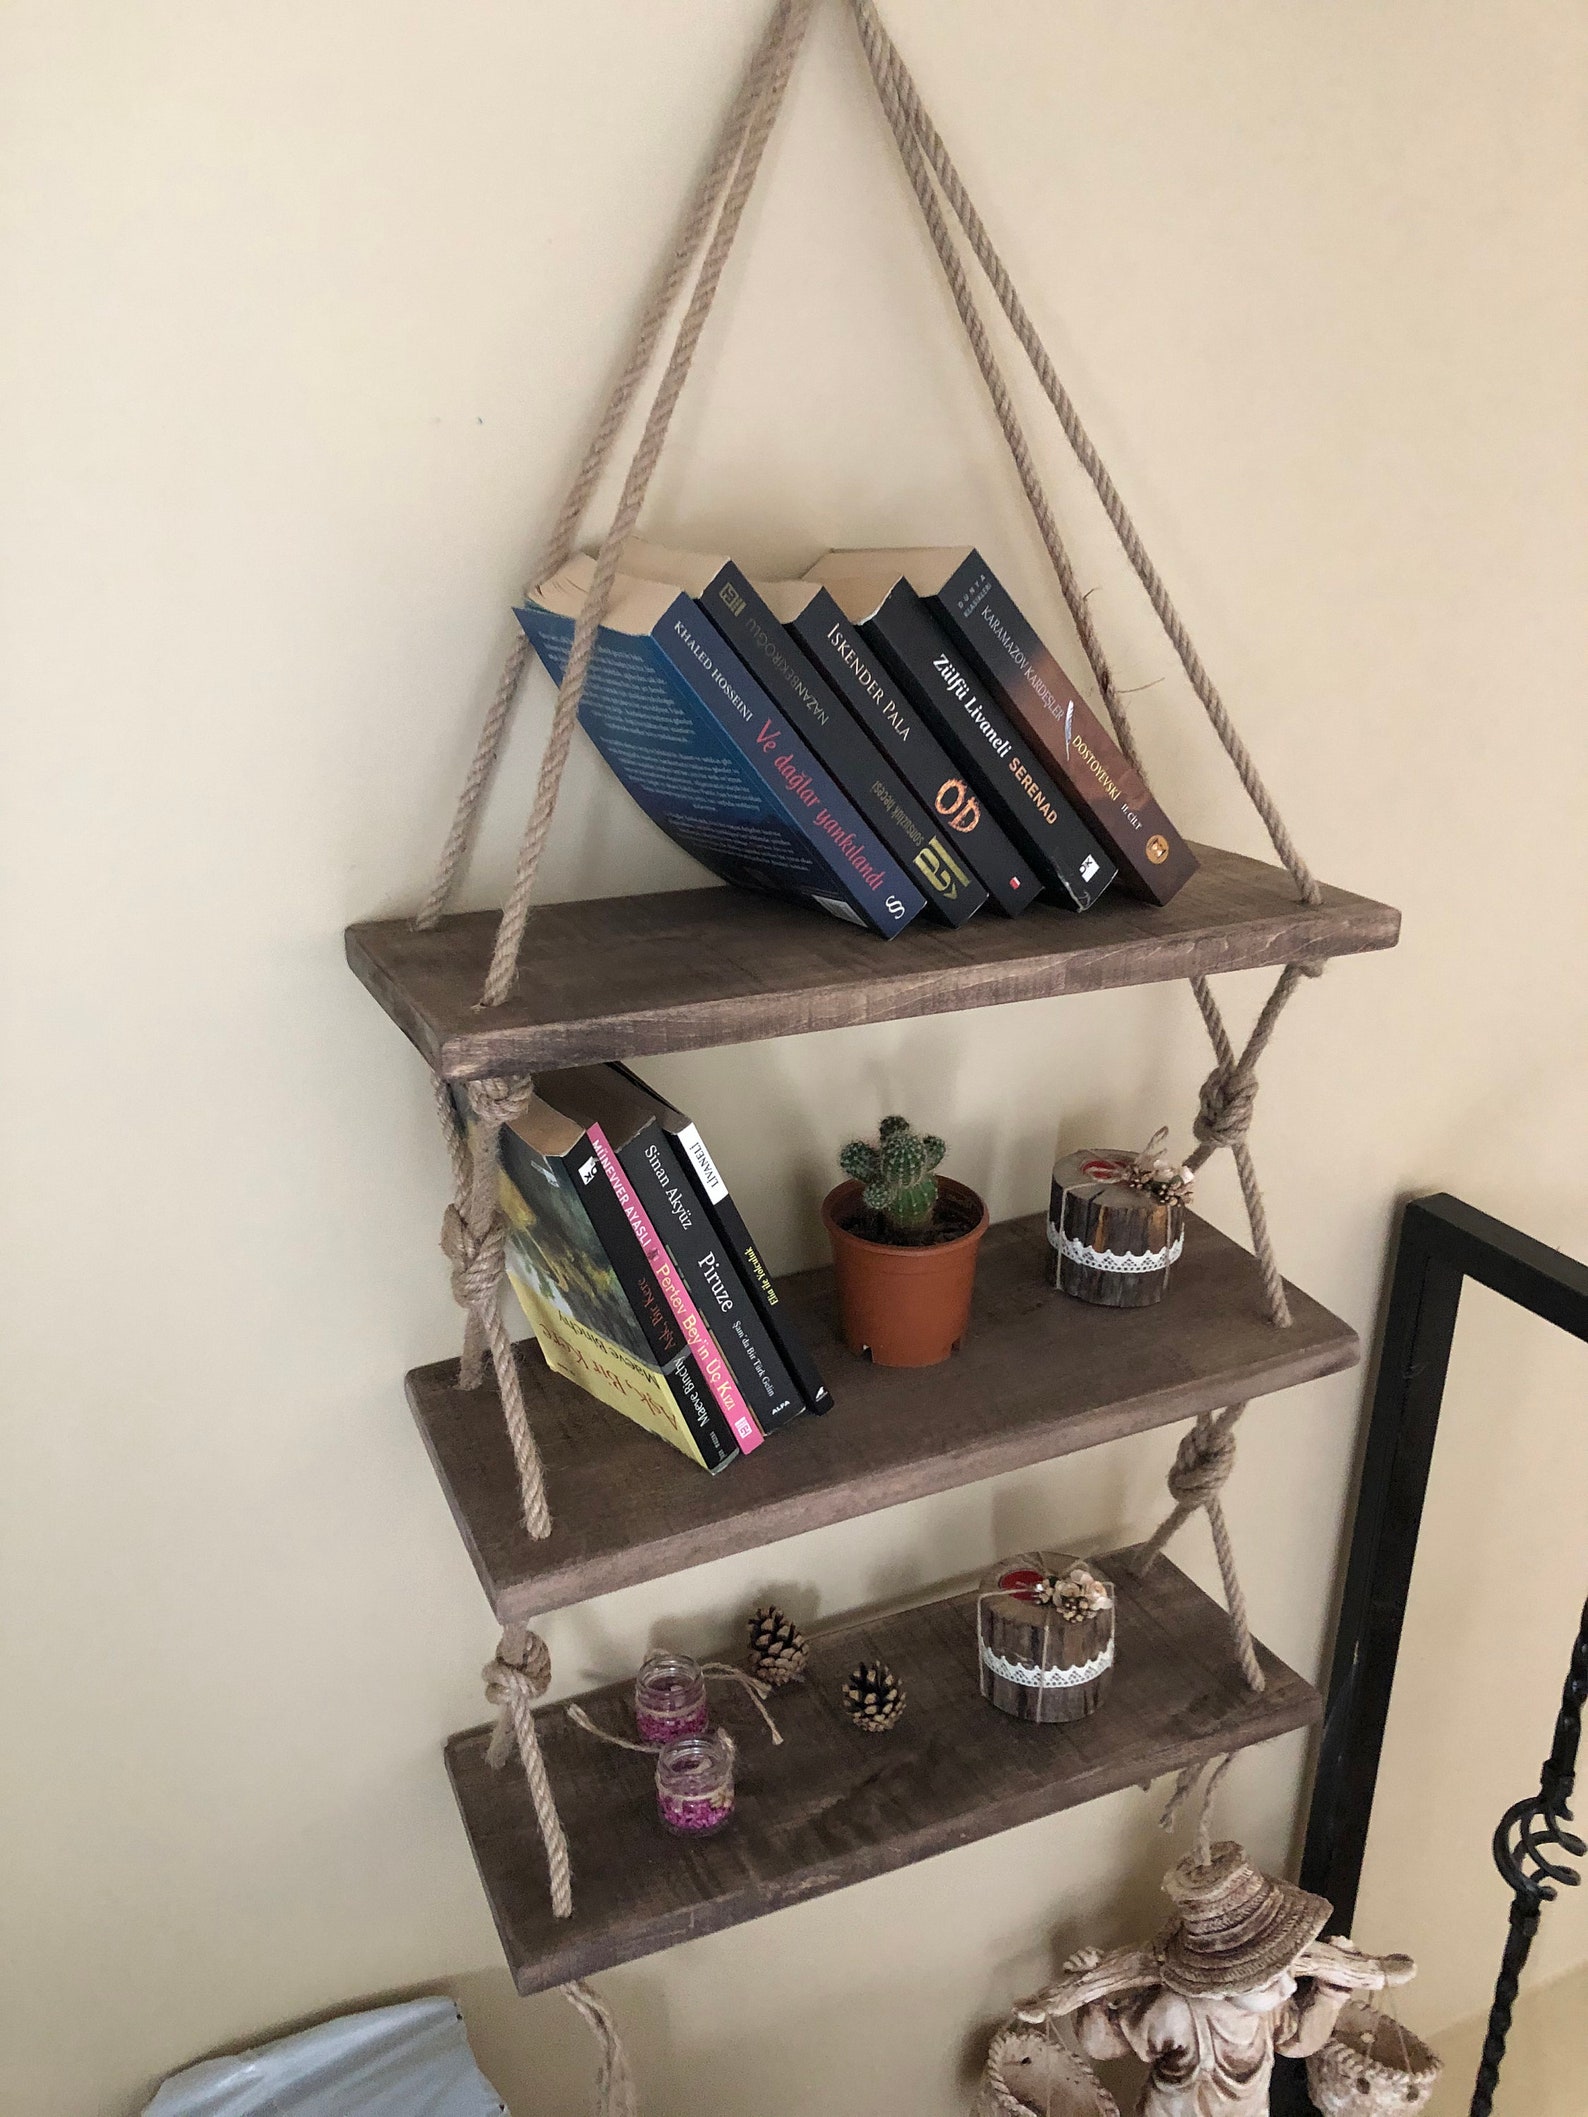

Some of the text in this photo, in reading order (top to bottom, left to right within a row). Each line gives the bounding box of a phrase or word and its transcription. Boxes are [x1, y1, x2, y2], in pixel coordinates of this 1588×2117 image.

[674, 621, 753, 722] KHALED HOSSEINI
[981, 604, 1064, 721] KARAMAZOV KARDEŞLER
[883, 701, 910, 742] PALA
[933, 653, 1012, 758] Zülfü Livaneli
[755, 719, 782, 753] Ve
[774, 754, 820, 808] dağlar
[813, 808, 887, 891] yankılandı
[872, 780, 924, 846] sonsuzluk hecesi
[935, 778, 981, 834] OD
[1009, 757, 1057, 825] SERENAD
[593, 1139, 652, 1247] MÜNEVVER AYASLI
[645, 1145, 692, 1230] Sinan Akyüz
[689, 1142, 719, 1188] LİVANELİ
[698, 1251, 734, 1313] Piruze
[745, 1246, 778, 1306] Elia ile Yolculuk
[539, 1323, 589, 1370] Kere
[558, 1310, 661, 1390] Maeve Binchy
[638, 1277, 676, 1351] Aşk, Bir Kere
[656, 1264, 686, 1314] Pertev
[682, 1314, 709, 1360] Bey'in
[706, 1358, 721, 1384] Üç
[717, 1382, 735, 1411] Kızı
[592, 1360, 627, 1395] Bir
[673, 1355, 710, 1428] Maeve Binchy
[732, 1320, 775, 1397] Şam'da Bir Türk Gelin
